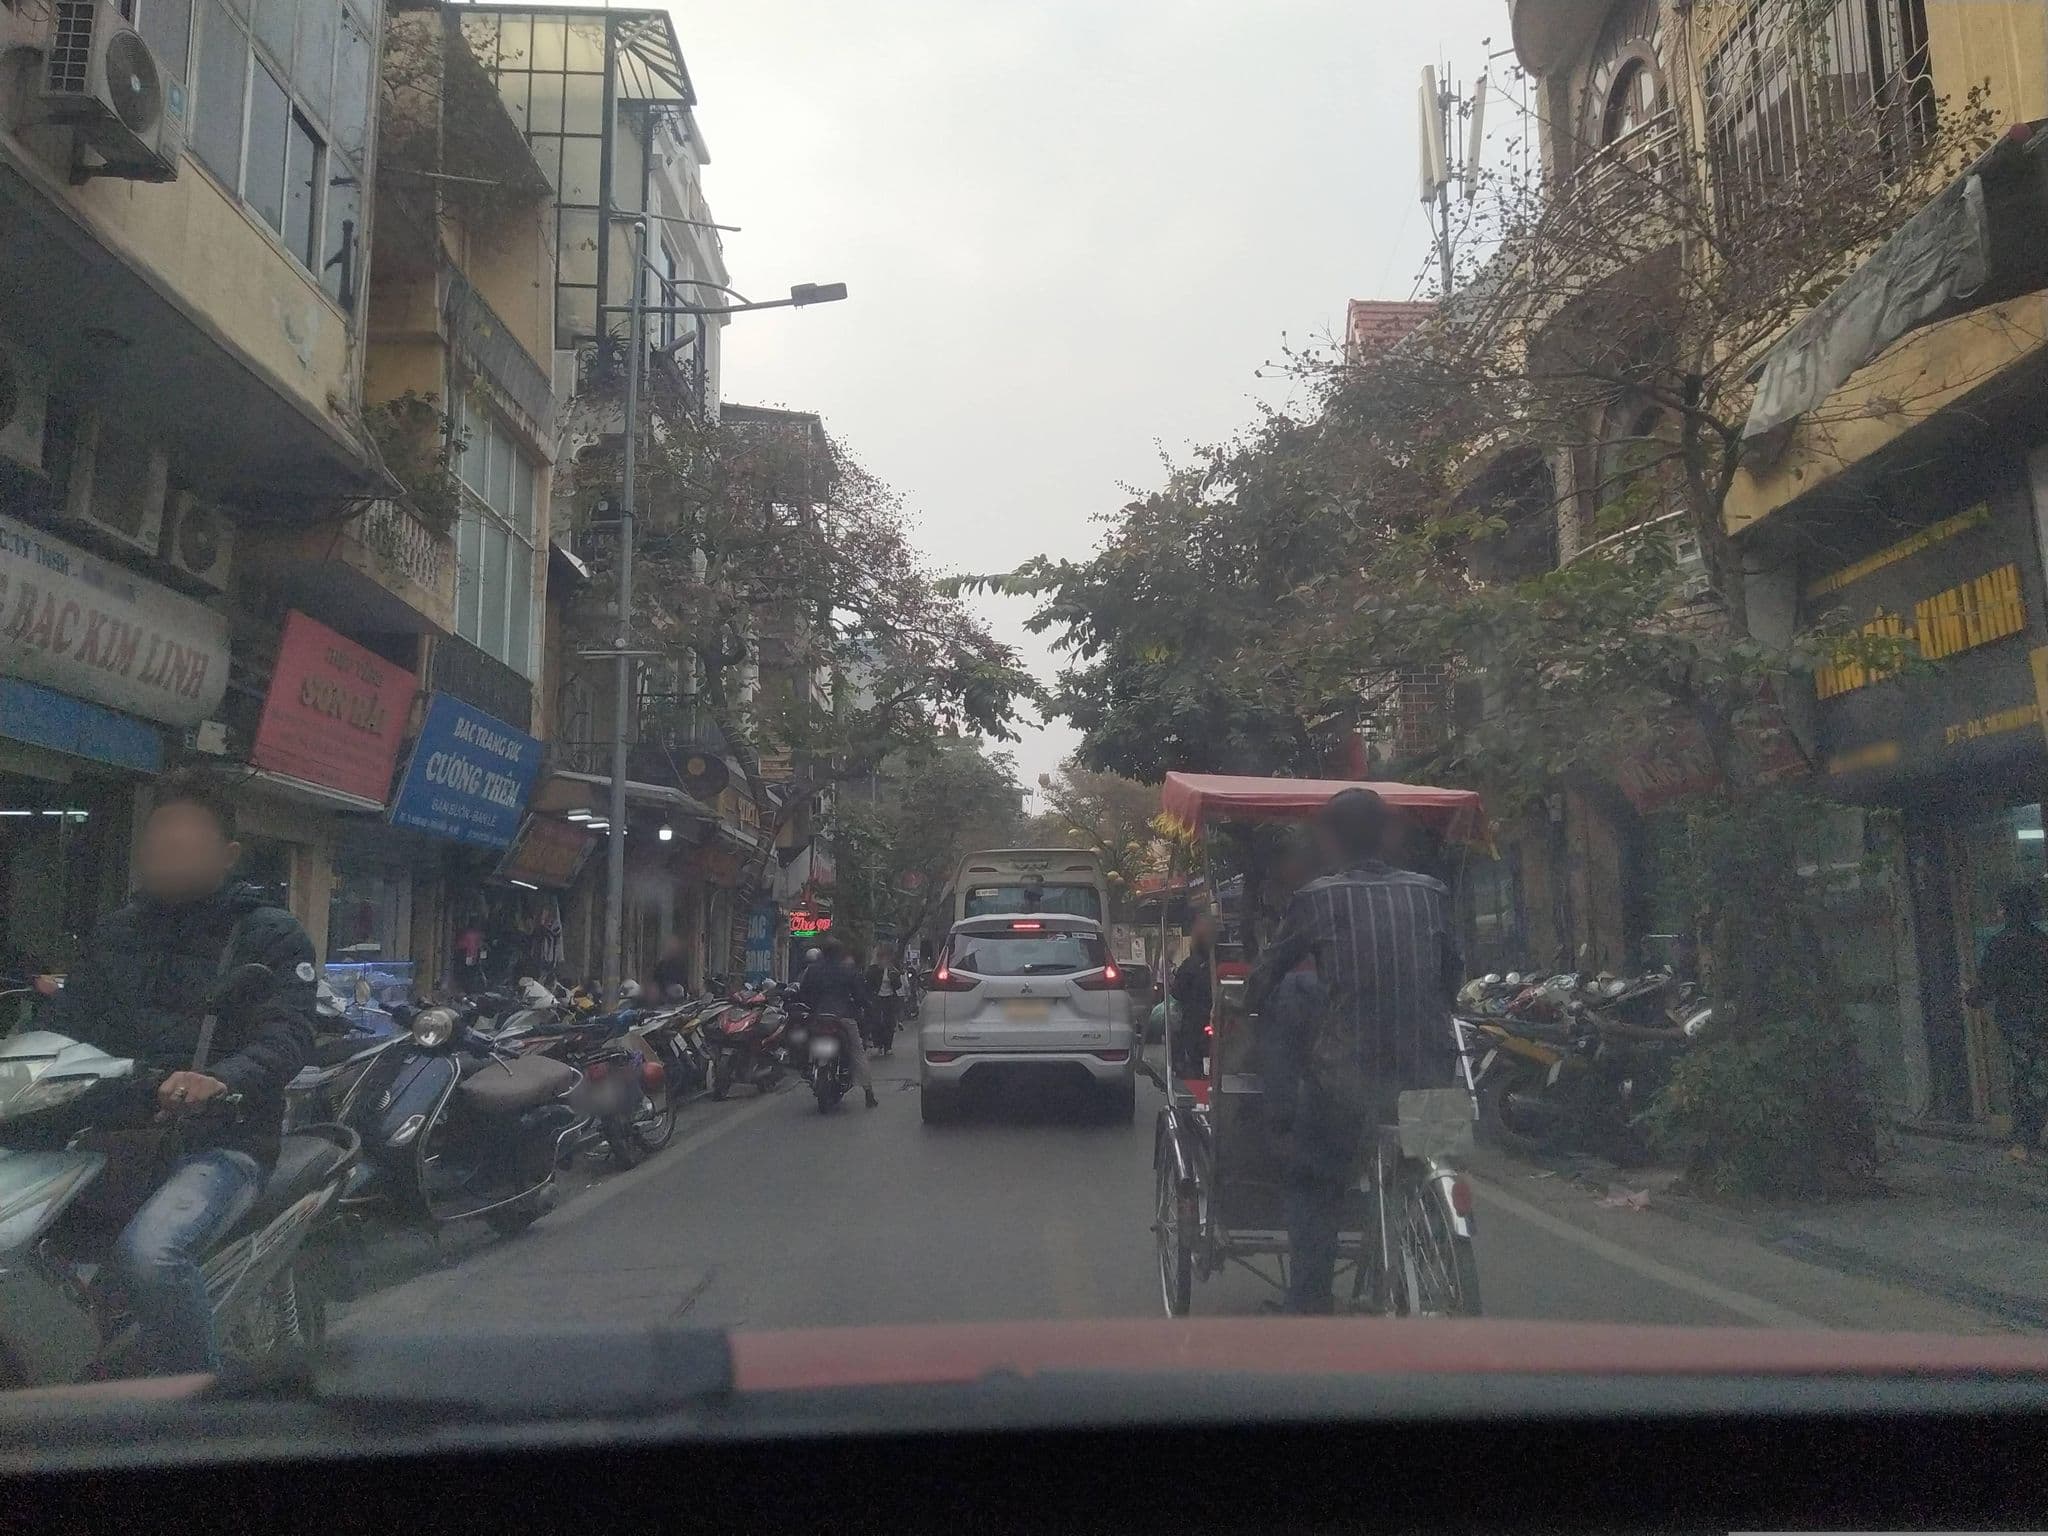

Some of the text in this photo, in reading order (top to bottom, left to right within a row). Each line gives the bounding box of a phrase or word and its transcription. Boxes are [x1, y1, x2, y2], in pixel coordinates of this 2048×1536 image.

[74, 609, 143, 677] KIM
[137, 632, 210, 699] LINH
[476, 728, 508, 756] TRANG
